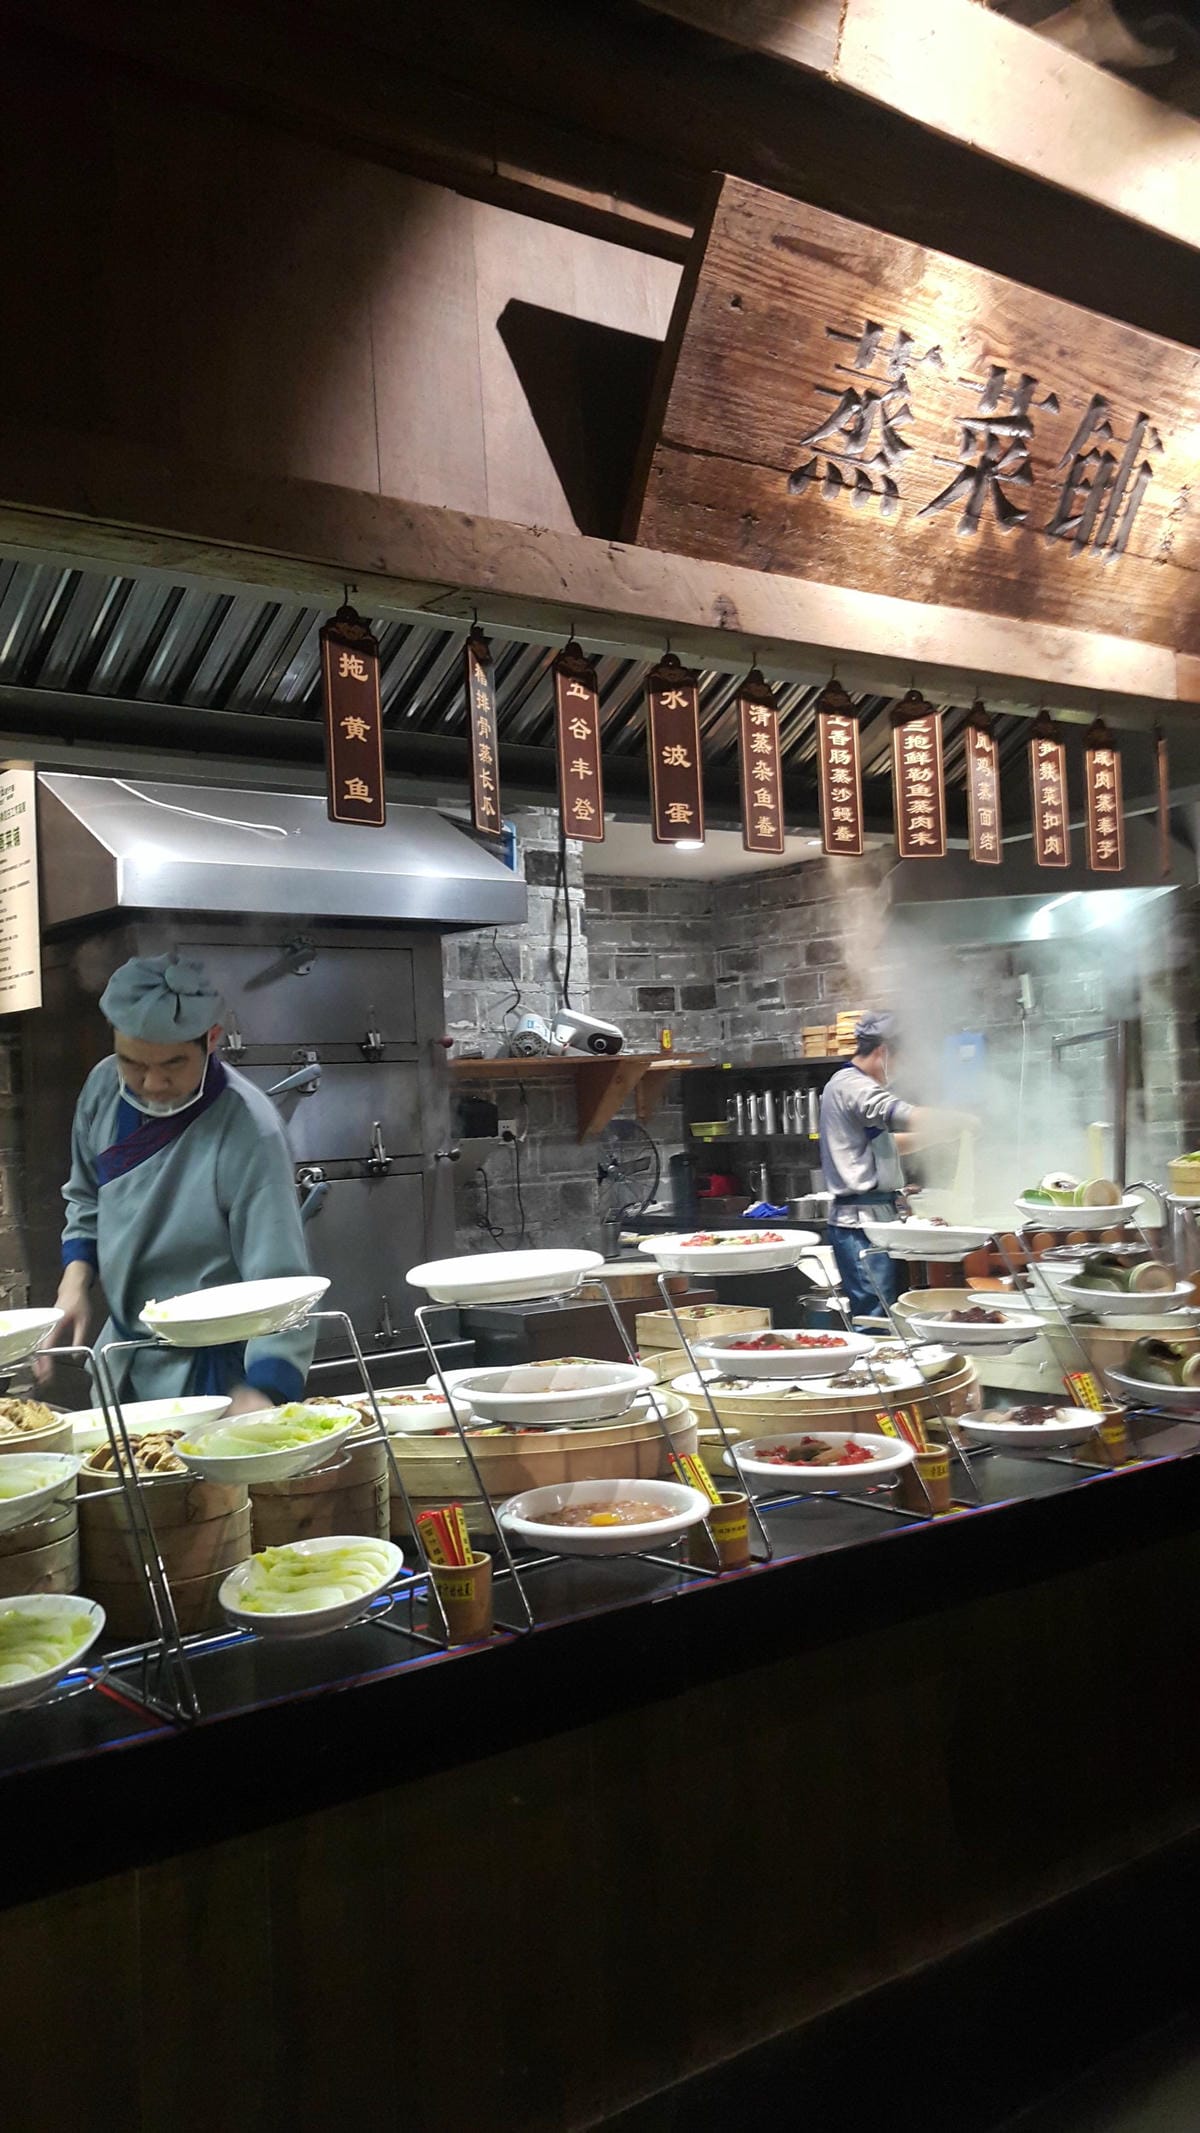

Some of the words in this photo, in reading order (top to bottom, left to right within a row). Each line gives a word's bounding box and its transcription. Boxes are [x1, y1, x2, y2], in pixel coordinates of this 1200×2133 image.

[338, 652, 374, 804] 拖黄鱼
[566, 679, 595, 821] 五谷丰登
[660, 689, 694, 824] 水波蛋
[749, 705, 777, 837] 清蒸杂鱼鲞
